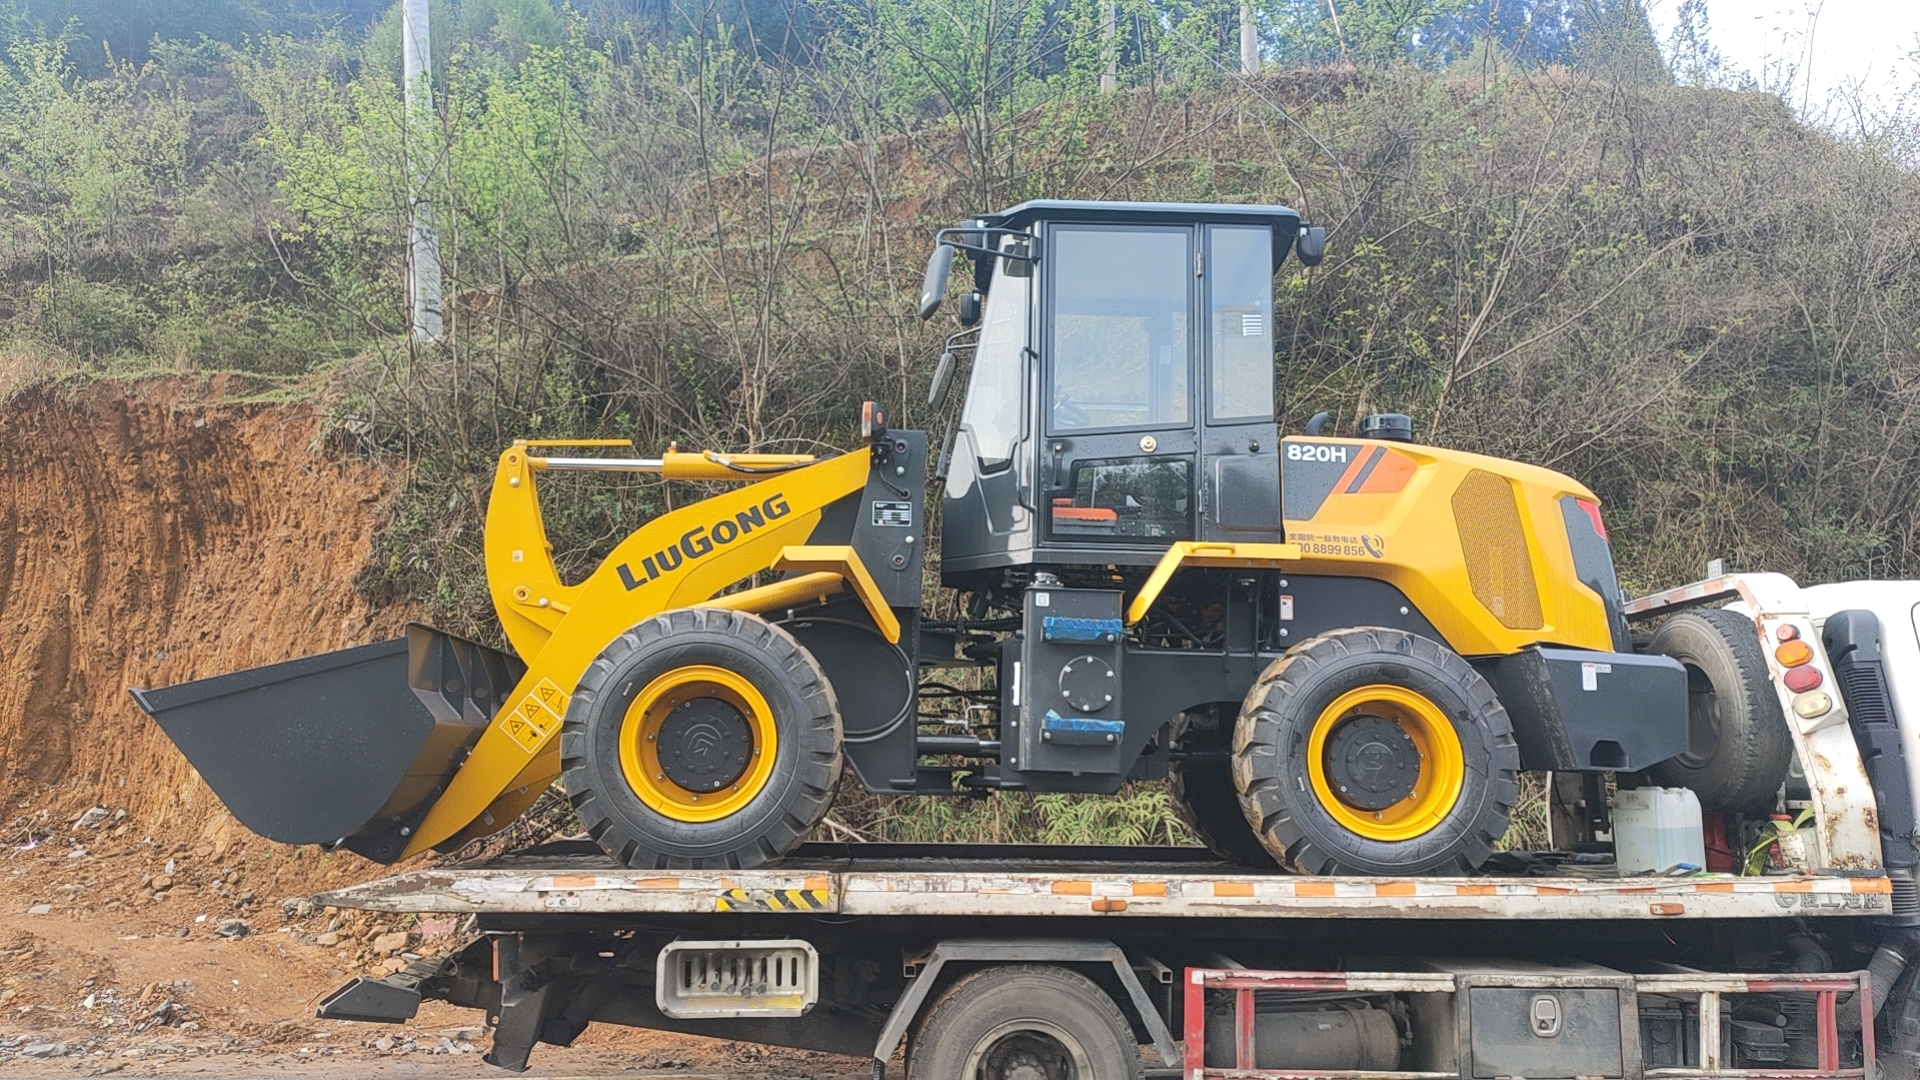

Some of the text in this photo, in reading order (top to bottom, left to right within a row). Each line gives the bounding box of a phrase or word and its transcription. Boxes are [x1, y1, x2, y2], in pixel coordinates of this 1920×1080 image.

[1287, 444, 1347, 463] 820H
[1289, 533, 1358, 544] 全国统一服务电话
[1313, 543, 1342, 555] 8899
[1343, 545, 1366, 556] 856
